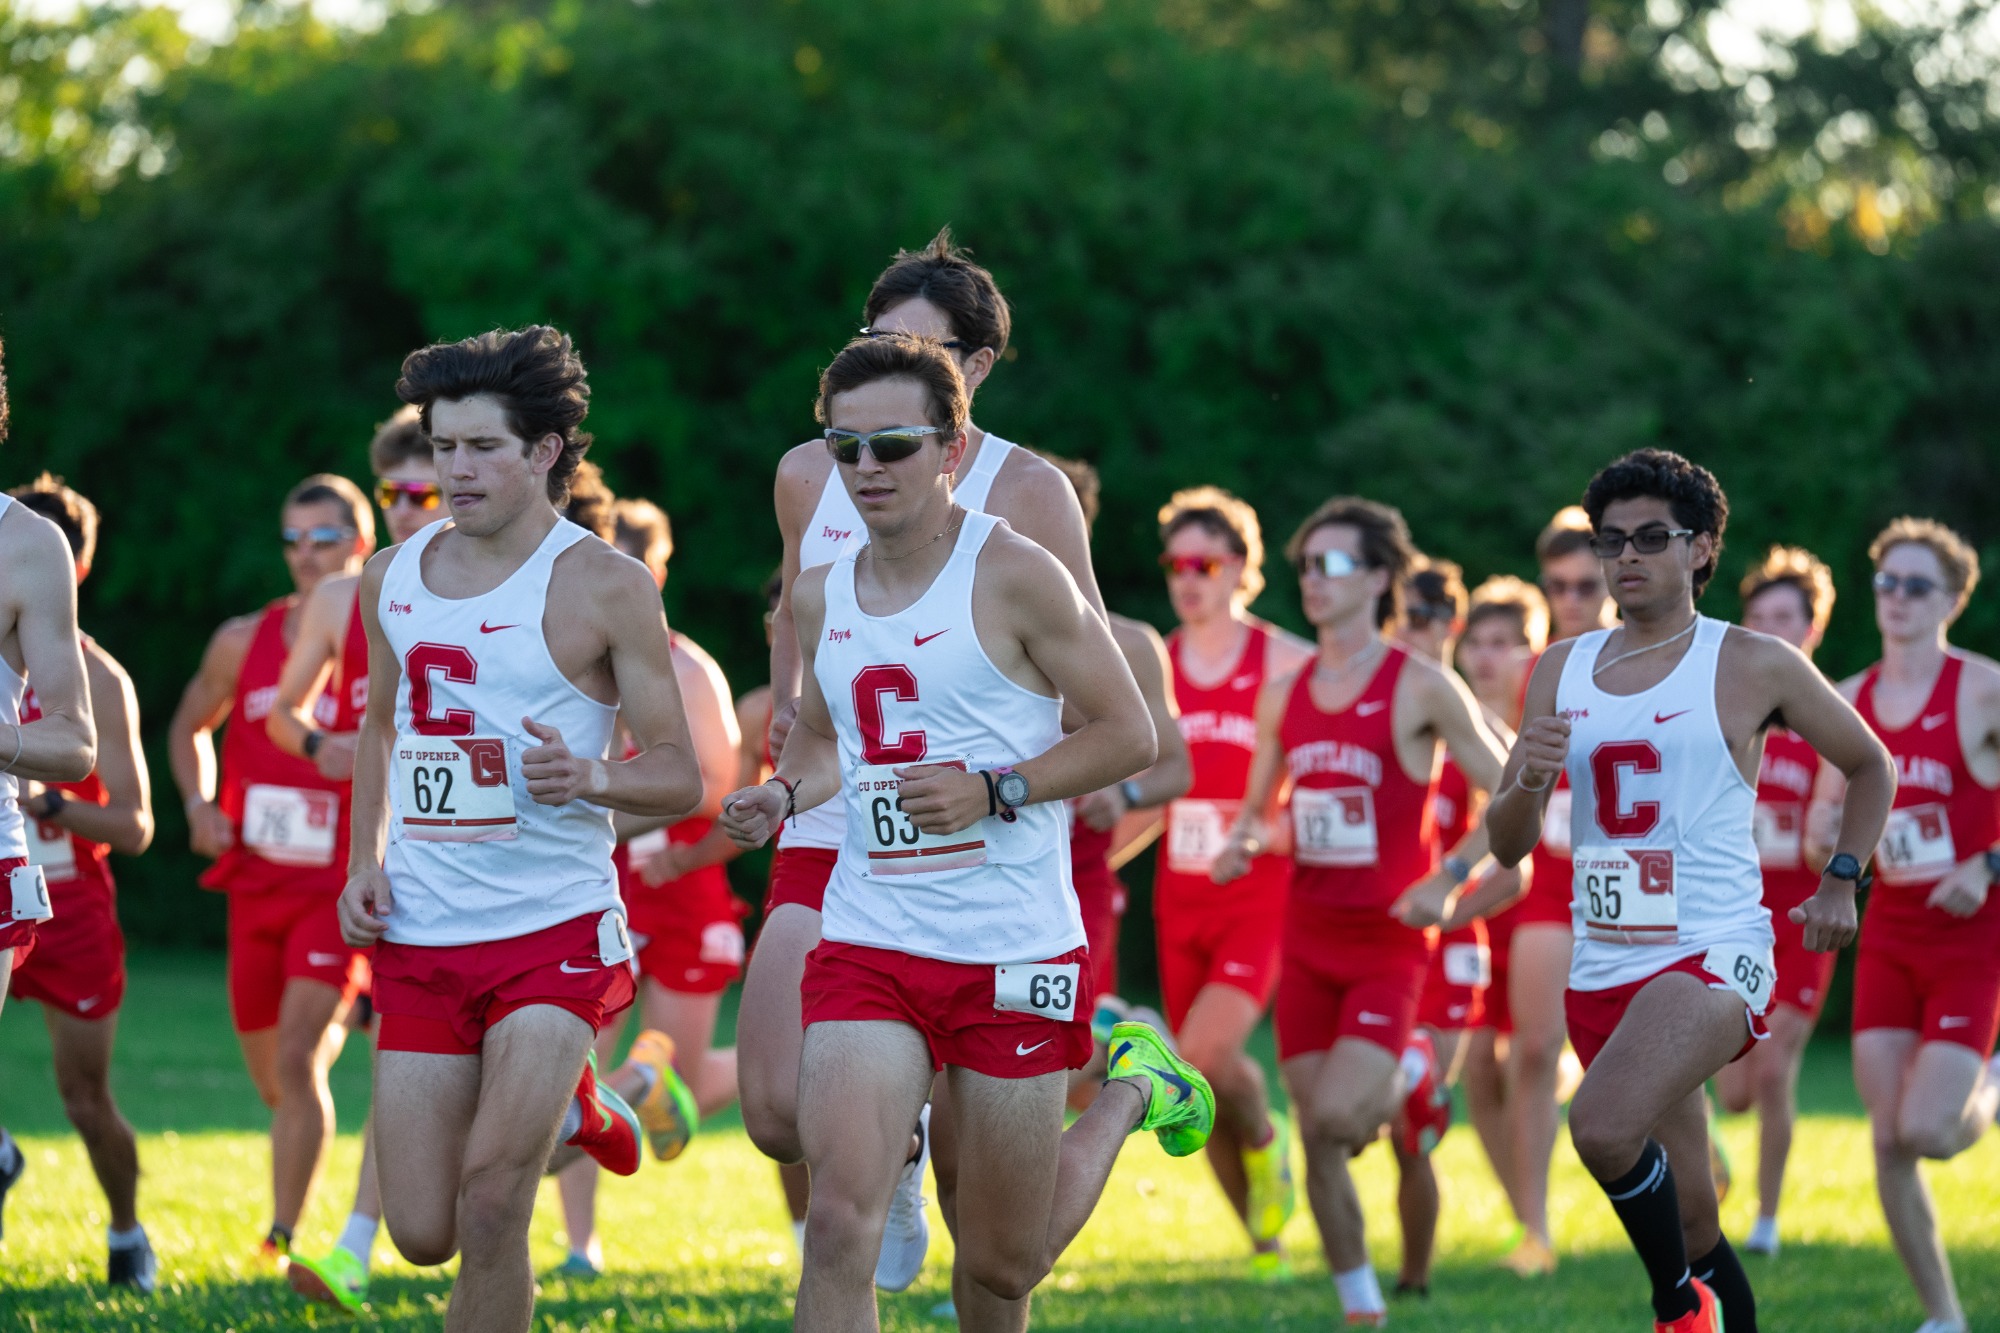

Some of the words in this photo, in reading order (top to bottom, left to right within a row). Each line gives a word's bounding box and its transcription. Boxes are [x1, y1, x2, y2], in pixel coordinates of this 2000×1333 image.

[822, 526, 842, 541] Ivy
[828, 629, 844, 643] Ivy
[405, 641, 477, 736] C
[852, 664, 927, 765] C
[400, 750, 412, 760] CU
[416, 752, 460, 761] OPENER
[469, 743, 504, 788] C
[413, 766, 456, 814] 62
[858, 781, 870, 791] CU
[874, 780, 904, 791] OPEN
[1589, 739, 1661, 839] C
[1589, 861, 1630, 870] OPENER
[1639, 852, 1670, 896] C
[1587, 874, 1621, 920] 65
[1030, 974, 1072, 1010] 63
[1733, 954, 1764, 994] 65
